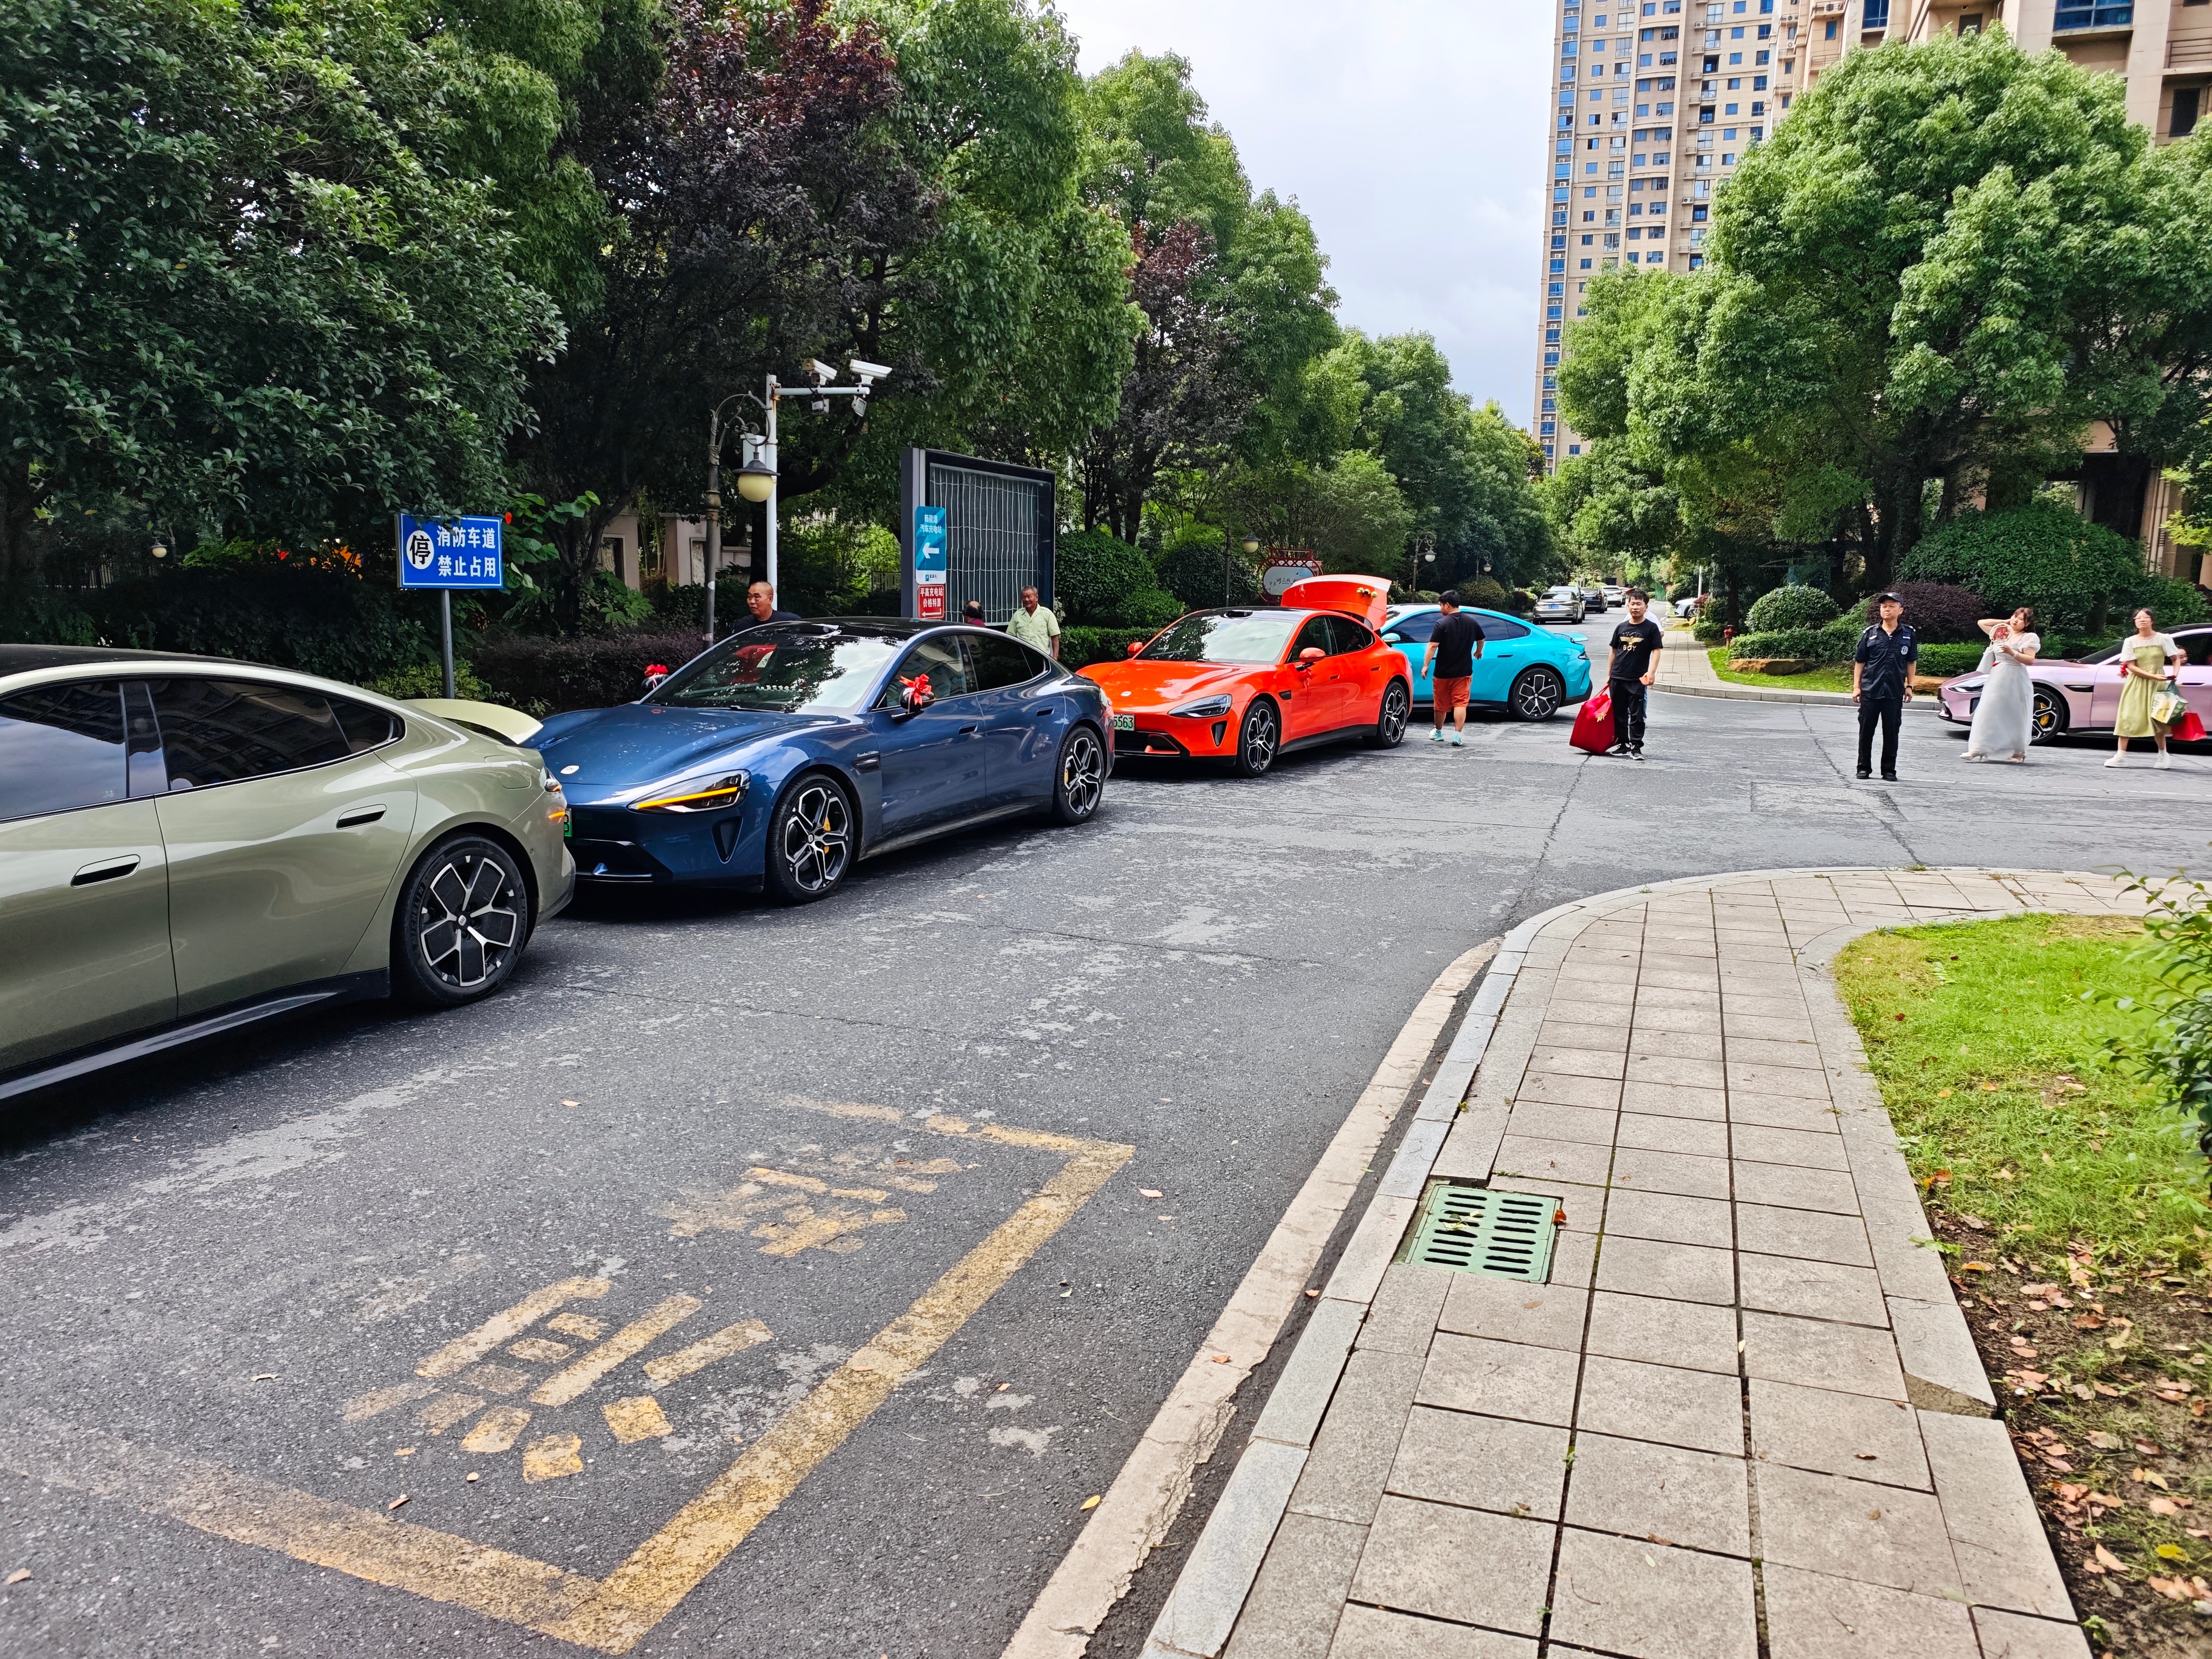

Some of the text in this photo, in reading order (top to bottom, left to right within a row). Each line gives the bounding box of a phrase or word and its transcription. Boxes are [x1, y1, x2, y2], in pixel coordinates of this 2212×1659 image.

[436, 525, 496, 549] 消防车道
[409, 535, 431, 565] 停
[437, 555, 496, 577] 禁止占用
[1114, 716, 1134, 729] 5563
